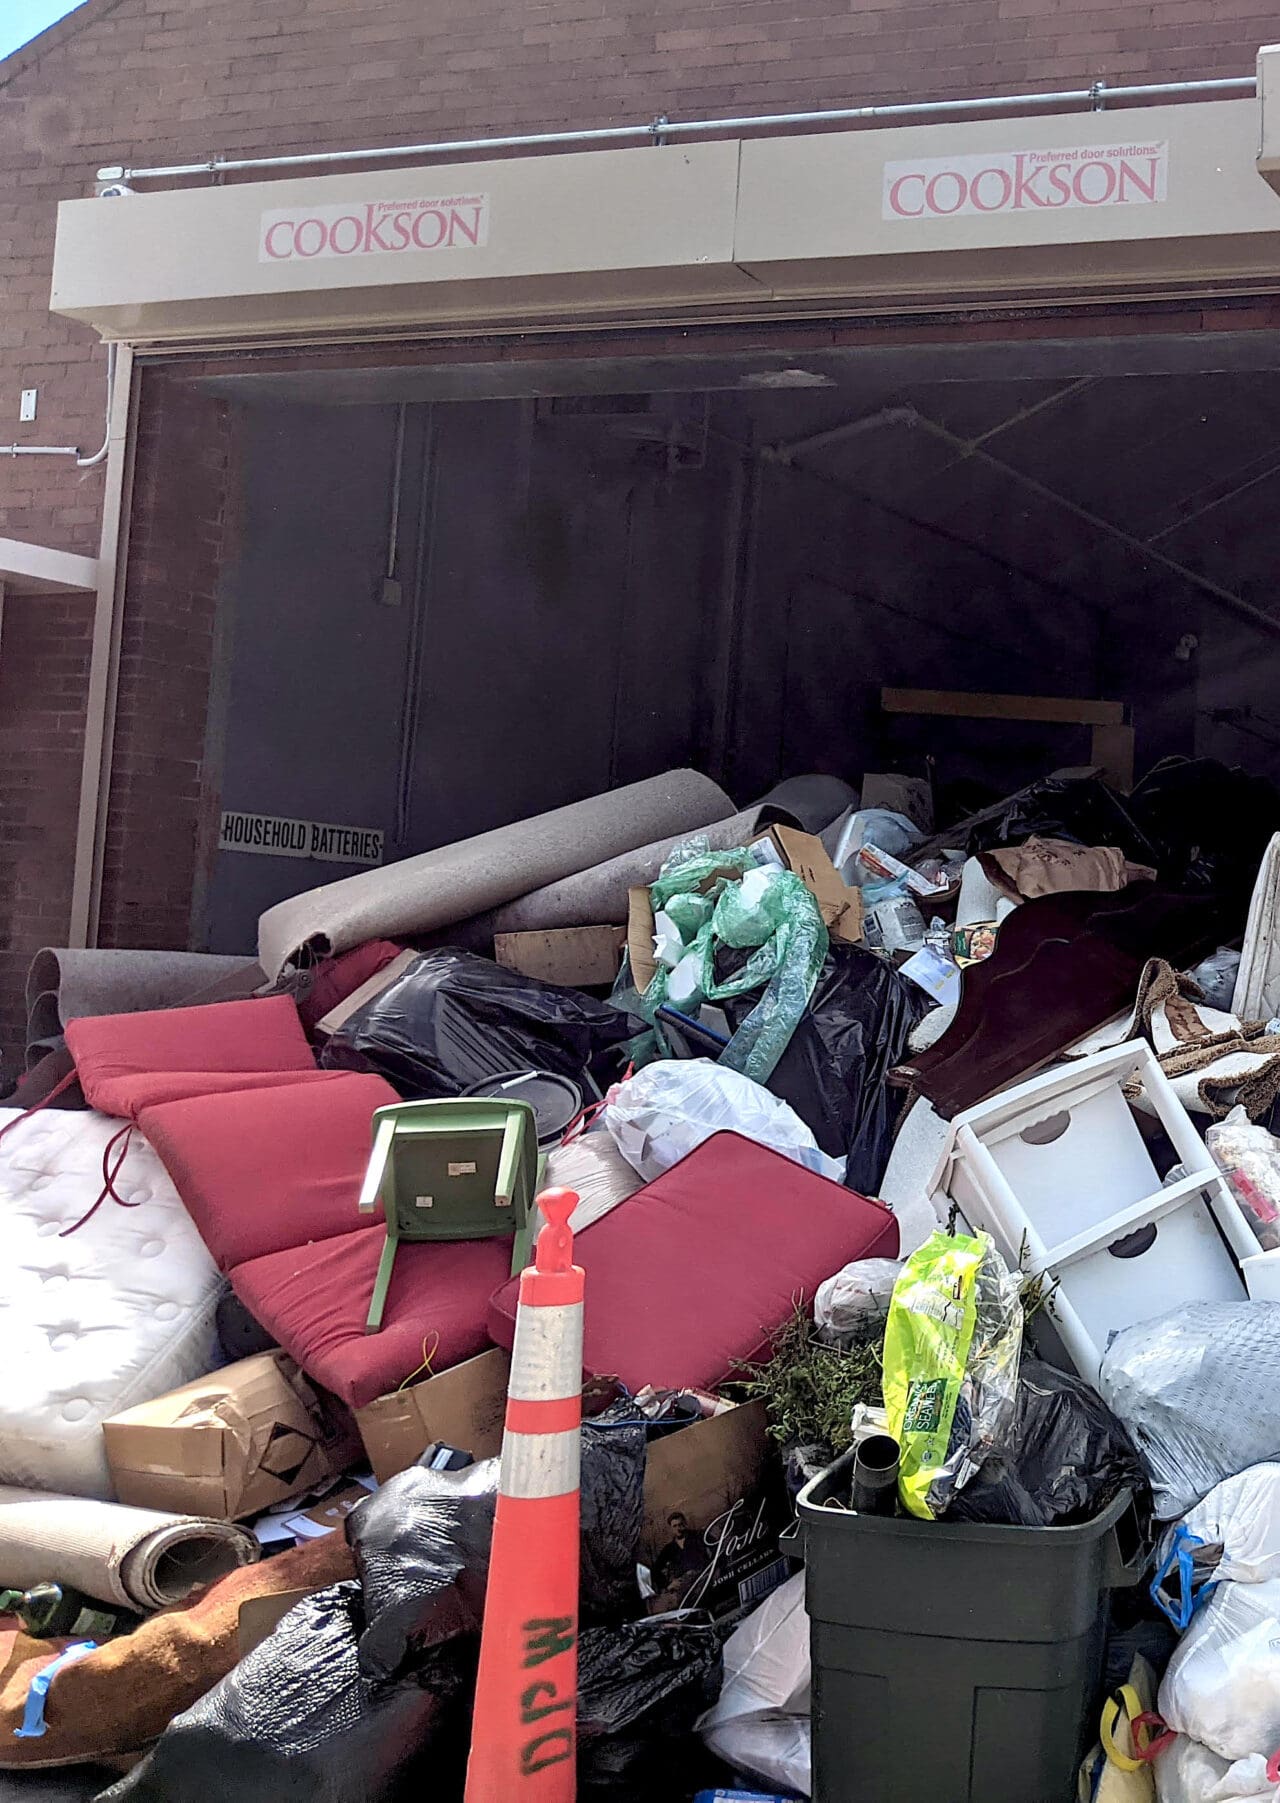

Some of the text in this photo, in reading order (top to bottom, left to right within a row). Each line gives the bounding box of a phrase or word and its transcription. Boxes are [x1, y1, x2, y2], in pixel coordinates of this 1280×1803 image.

[1029, 150, 1078, 162] Preferred
[1081, 149, 1105, 160] door
[419, 199, 440, 209] door
[889, 154, 1160, 216] COOKSON
[265, 204, 483, 259] COOKSON
[223, 815, 380, 860] HOUSEHOLD BATTERIES
[679, 1497, 767, 1620] Josh
[521, 1616, 575, 1777] DPW
